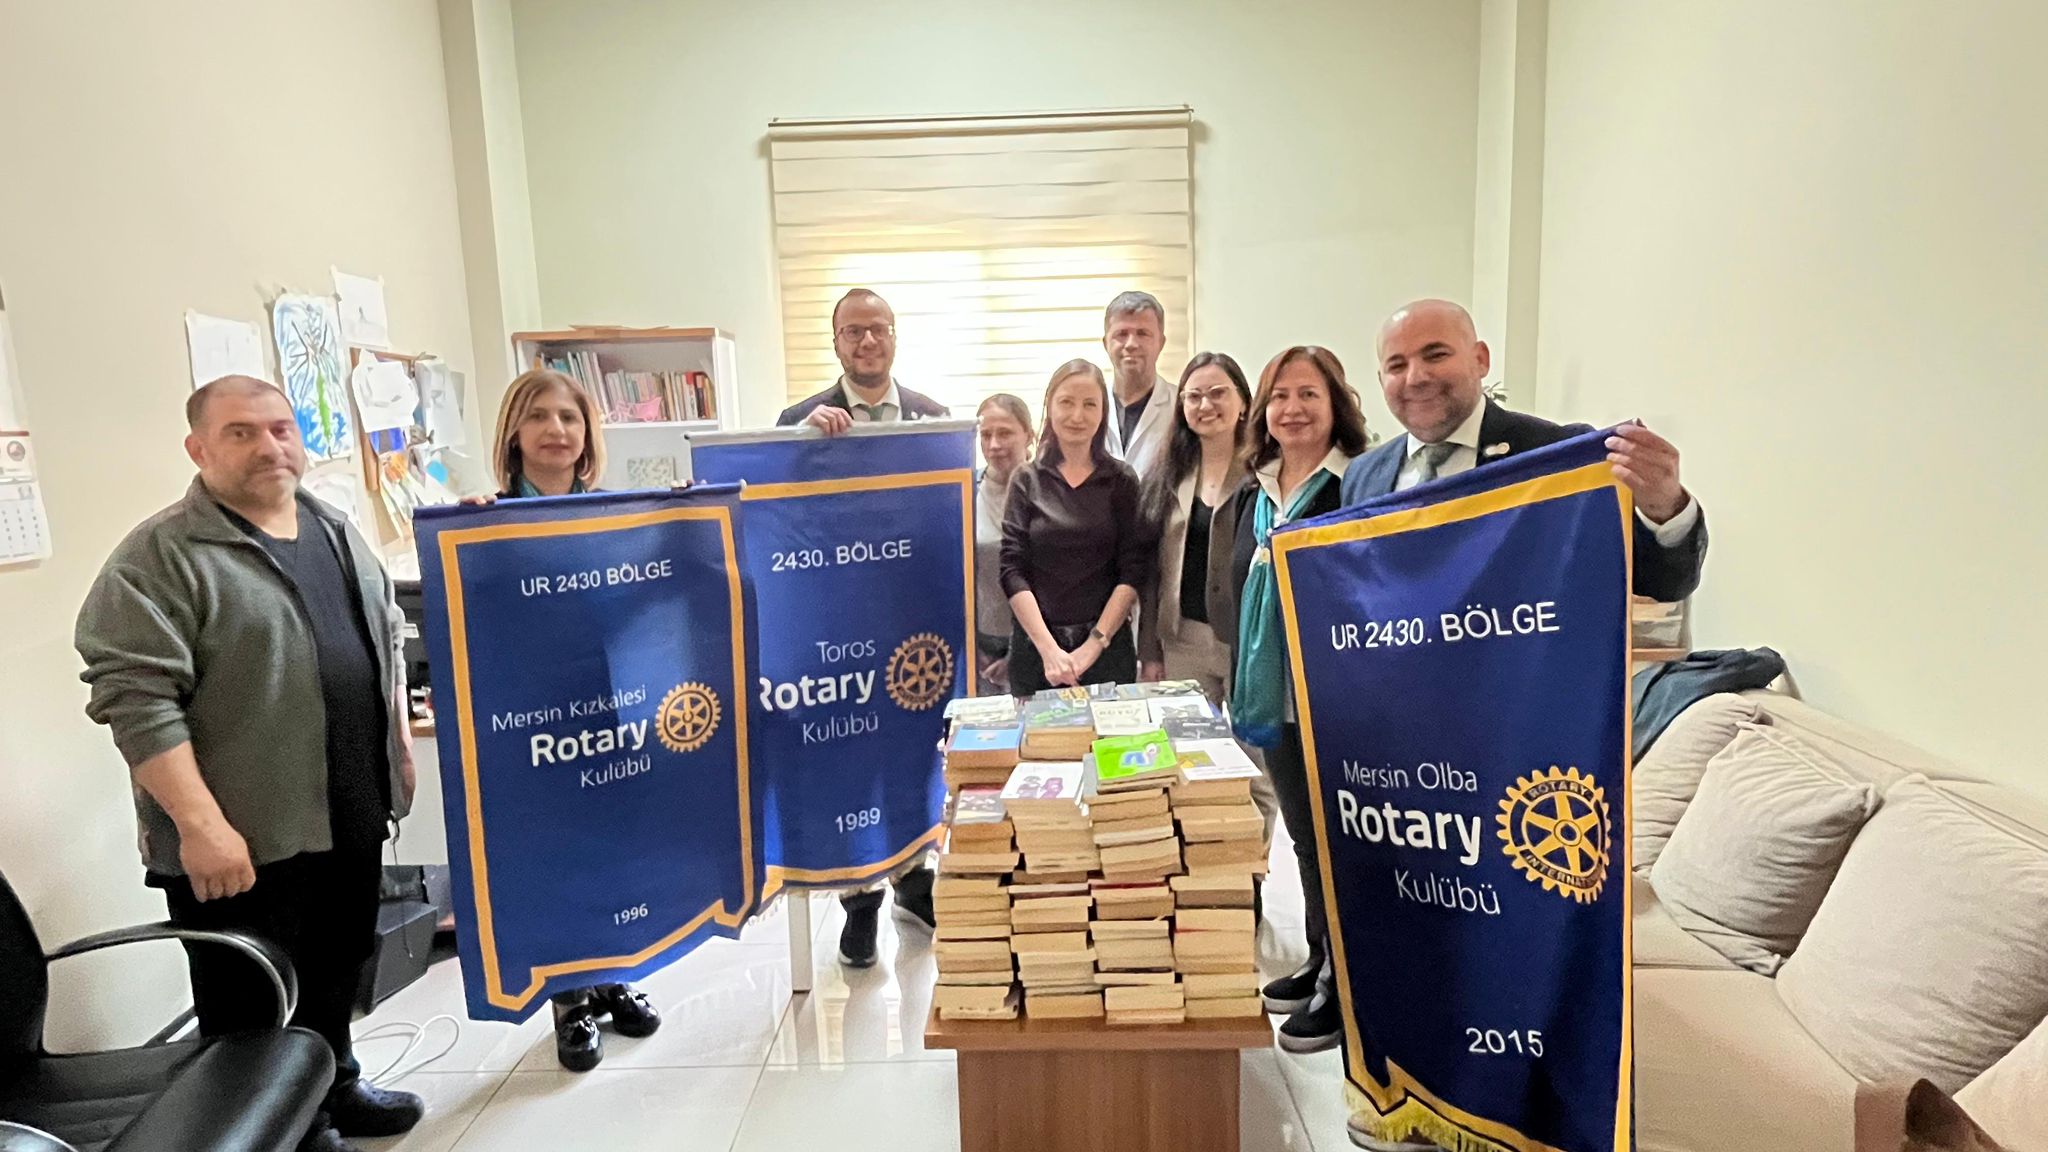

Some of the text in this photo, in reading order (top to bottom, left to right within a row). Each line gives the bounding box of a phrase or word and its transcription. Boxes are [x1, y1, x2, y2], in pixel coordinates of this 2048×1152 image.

[771, 539, 912, 572] 2430. BÖLGE
[521, 559, 673, 597] UR 2430 BÖLGE
[1331, 601, 1560, 651] UR 2430. BÖLGE
[816, 639, 876, 664] Toros
[492, 684, 647, 733] Mersin Kızkalesi
[530, 718, 648, 767] Rotary
[802, 711, 879, 745] Kulübü
[580, 754, 651, 788] Kulübü
[1343, 760, 1478, 792] Mersin Olba
[1527, 781, 1590, 799] ROTARY
[835, 807, 880, 834] 1989
[1337, 789, 1481, 866] Rotary
[1395, 869, 1501, 915] Kulübü
[614, 903, 649, 926] 1996
[1465, 1027, 1543, 1058] 2015
